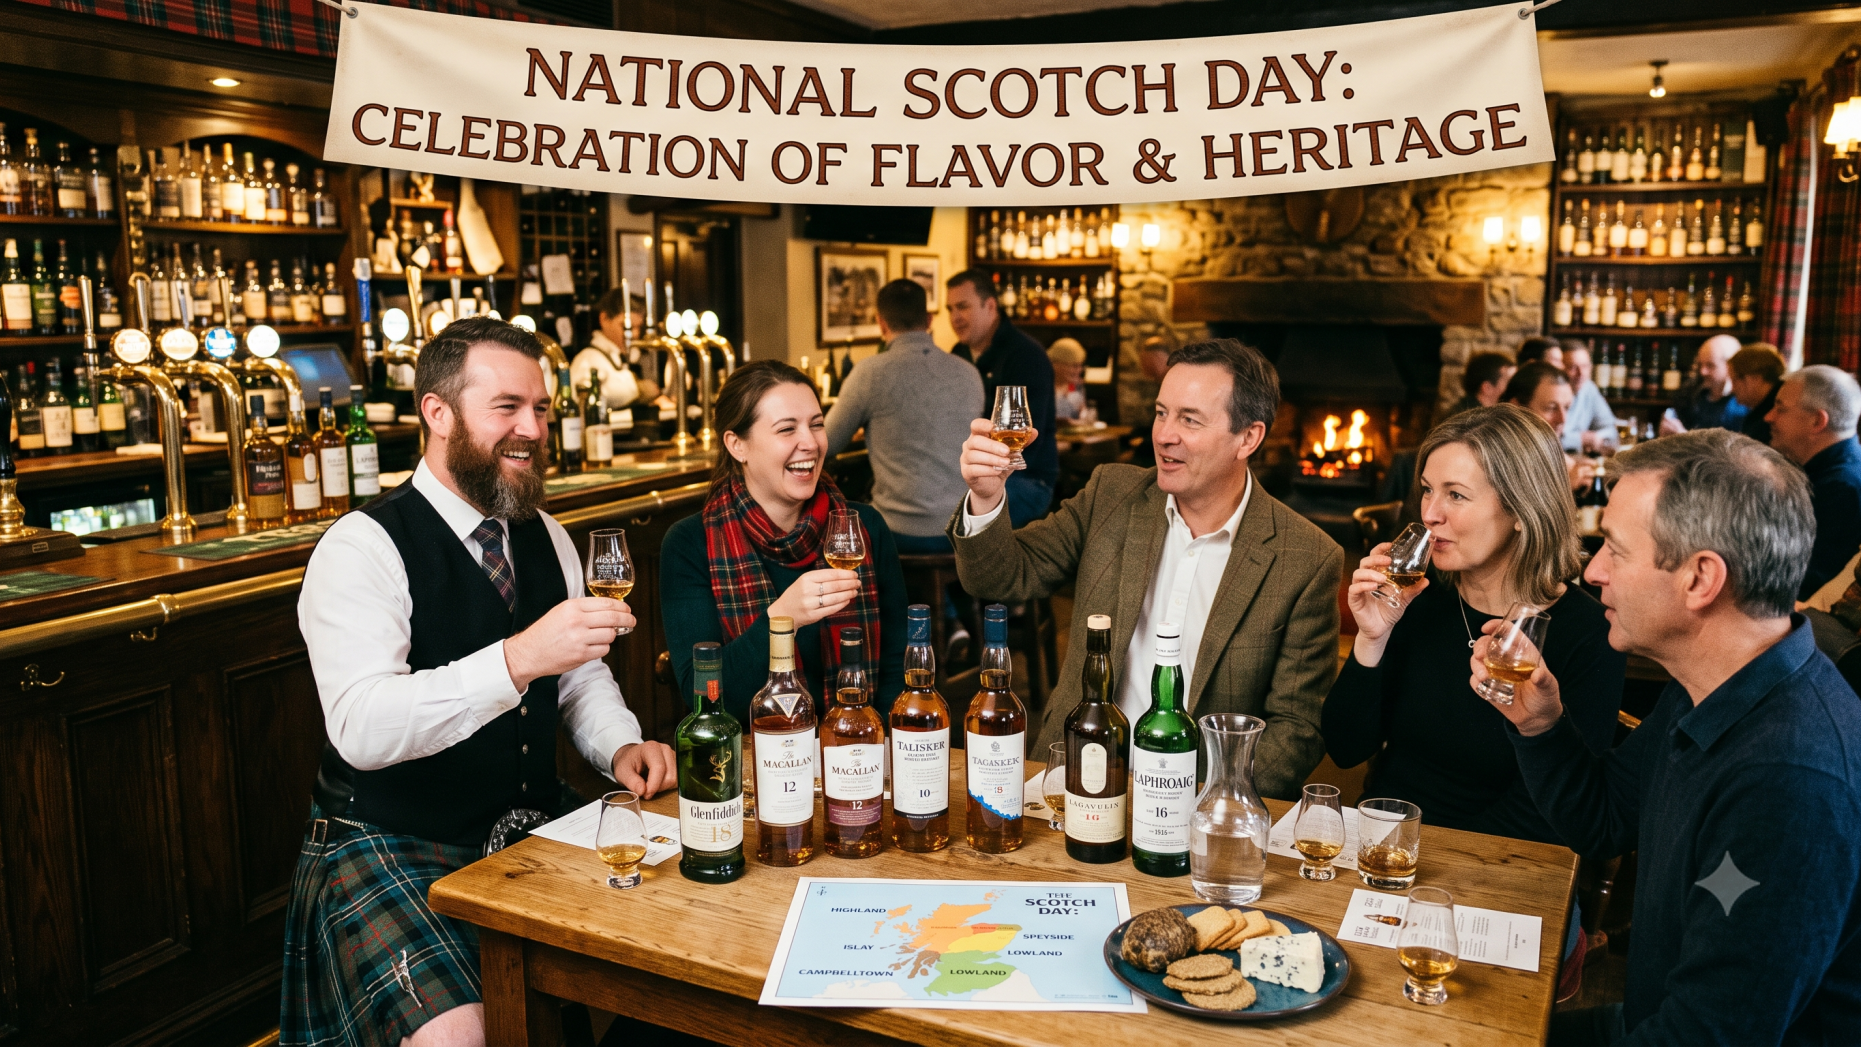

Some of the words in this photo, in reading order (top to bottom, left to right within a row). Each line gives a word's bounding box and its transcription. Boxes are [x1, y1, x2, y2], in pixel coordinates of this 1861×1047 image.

[524, 47, 878, 118] NATIONAL
[903, 62, 1180, 120] SCOTCH
[1205, 50, 1355, 111] DAY:
[351, 103, 749, 182] CELEBRATION
[771, 140, 848, 186] OF
[870, 140, 1110, 188] FLAVOR
[1132, 138, 1178, 184] &
[1201, 102, 1528, 180] HERITAGE
[897, 741, 945, 752] TALISKER
[763, 756, 812, 768] MACALLAN
[832, 763, 880, 776] MACALLAN
[784, 781, 796, 792] 12
[920, 789, 930, 798] 10
[690, 801, 740, 820] Glenfiddich
[852, 800, 862, 810] 12
[1156, 807, 1168, 818] 16
[711, 824, 732, 842] 18
[1025, 898, 1096, 906] SCOTCH
